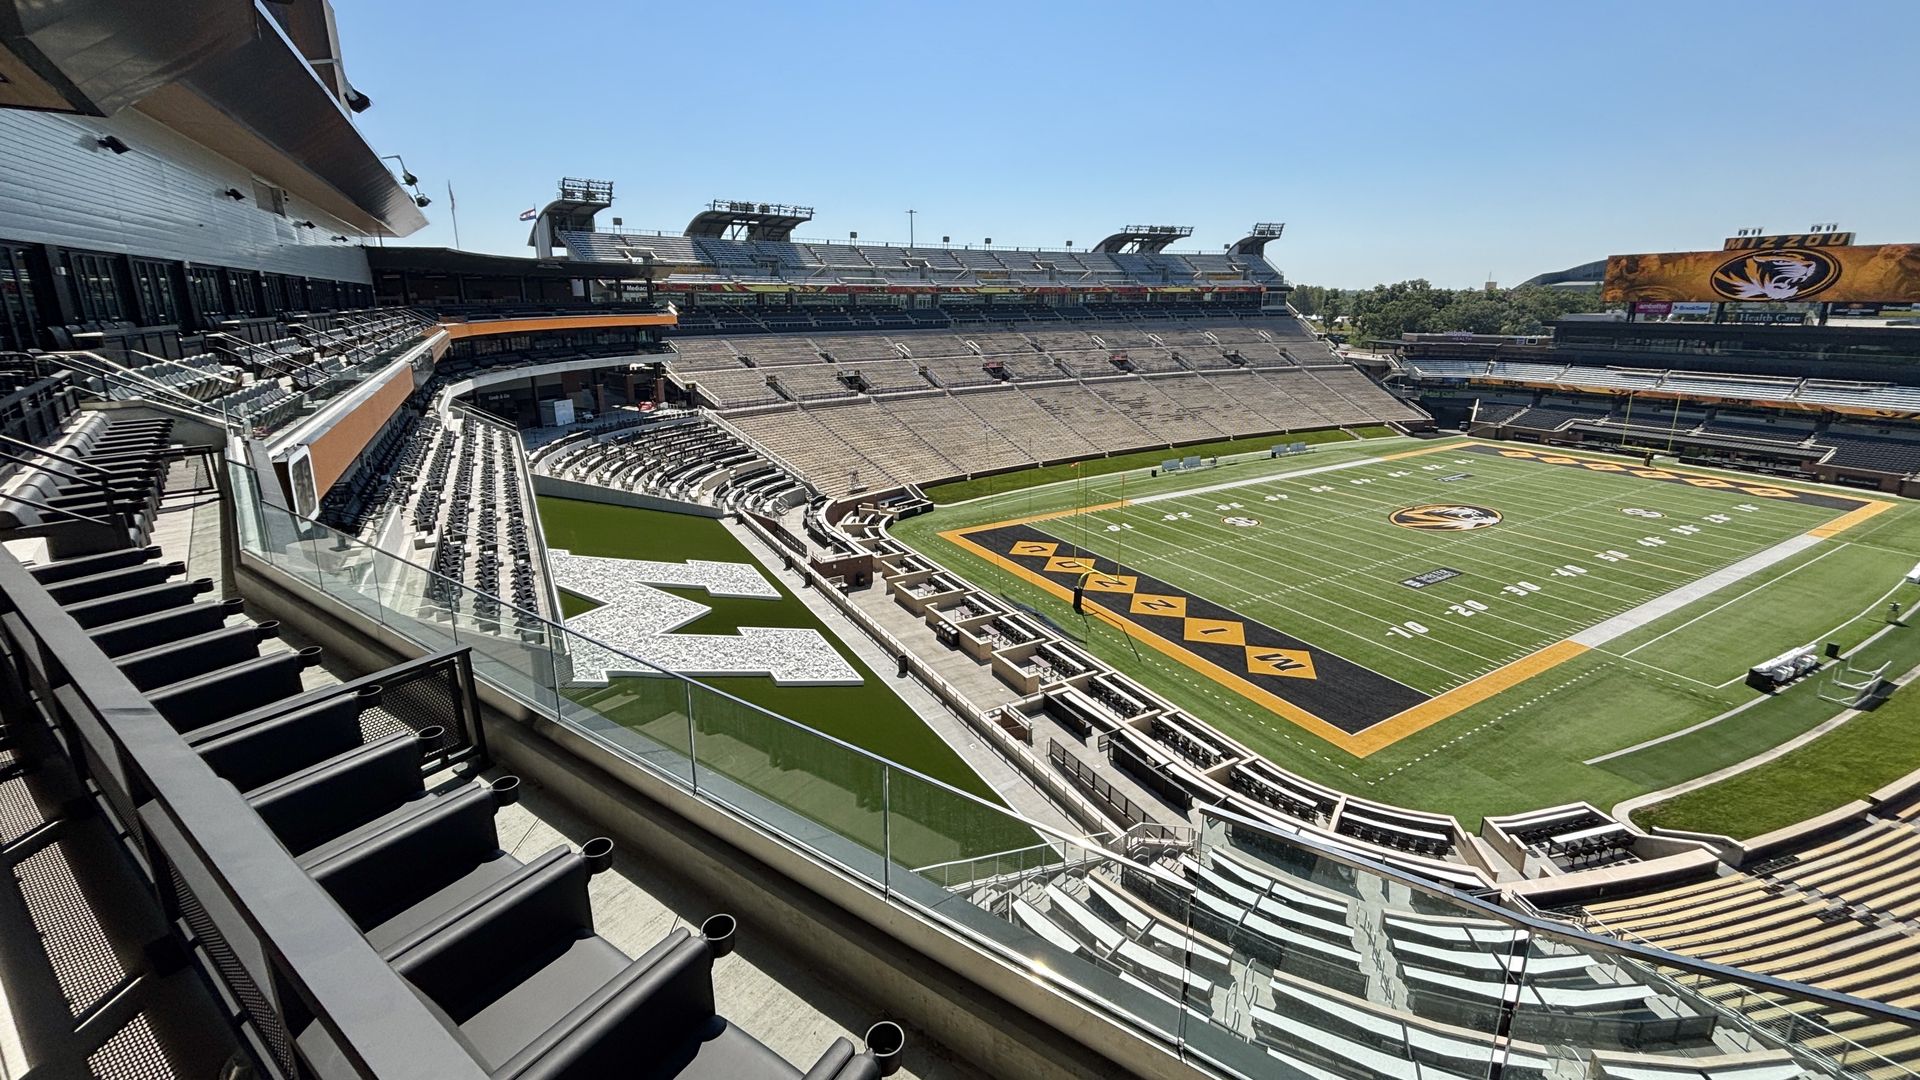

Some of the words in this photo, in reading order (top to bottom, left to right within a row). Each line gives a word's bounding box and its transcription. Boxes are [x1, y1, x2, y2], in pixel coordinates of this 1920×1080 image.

[1726, 232, 1849, 250] MIZZOU
[1738, 313, 1773, 323] Health
[1775, 313, 1802, 323] Care
[1594, 550, 1630, 562] 50
[1553, 564, 1588, 577] 40
[1503, 581, 1542, 597] 30
[1451, 599, 1489, 617] 20
[1390, 620, 1430, 639] 10
